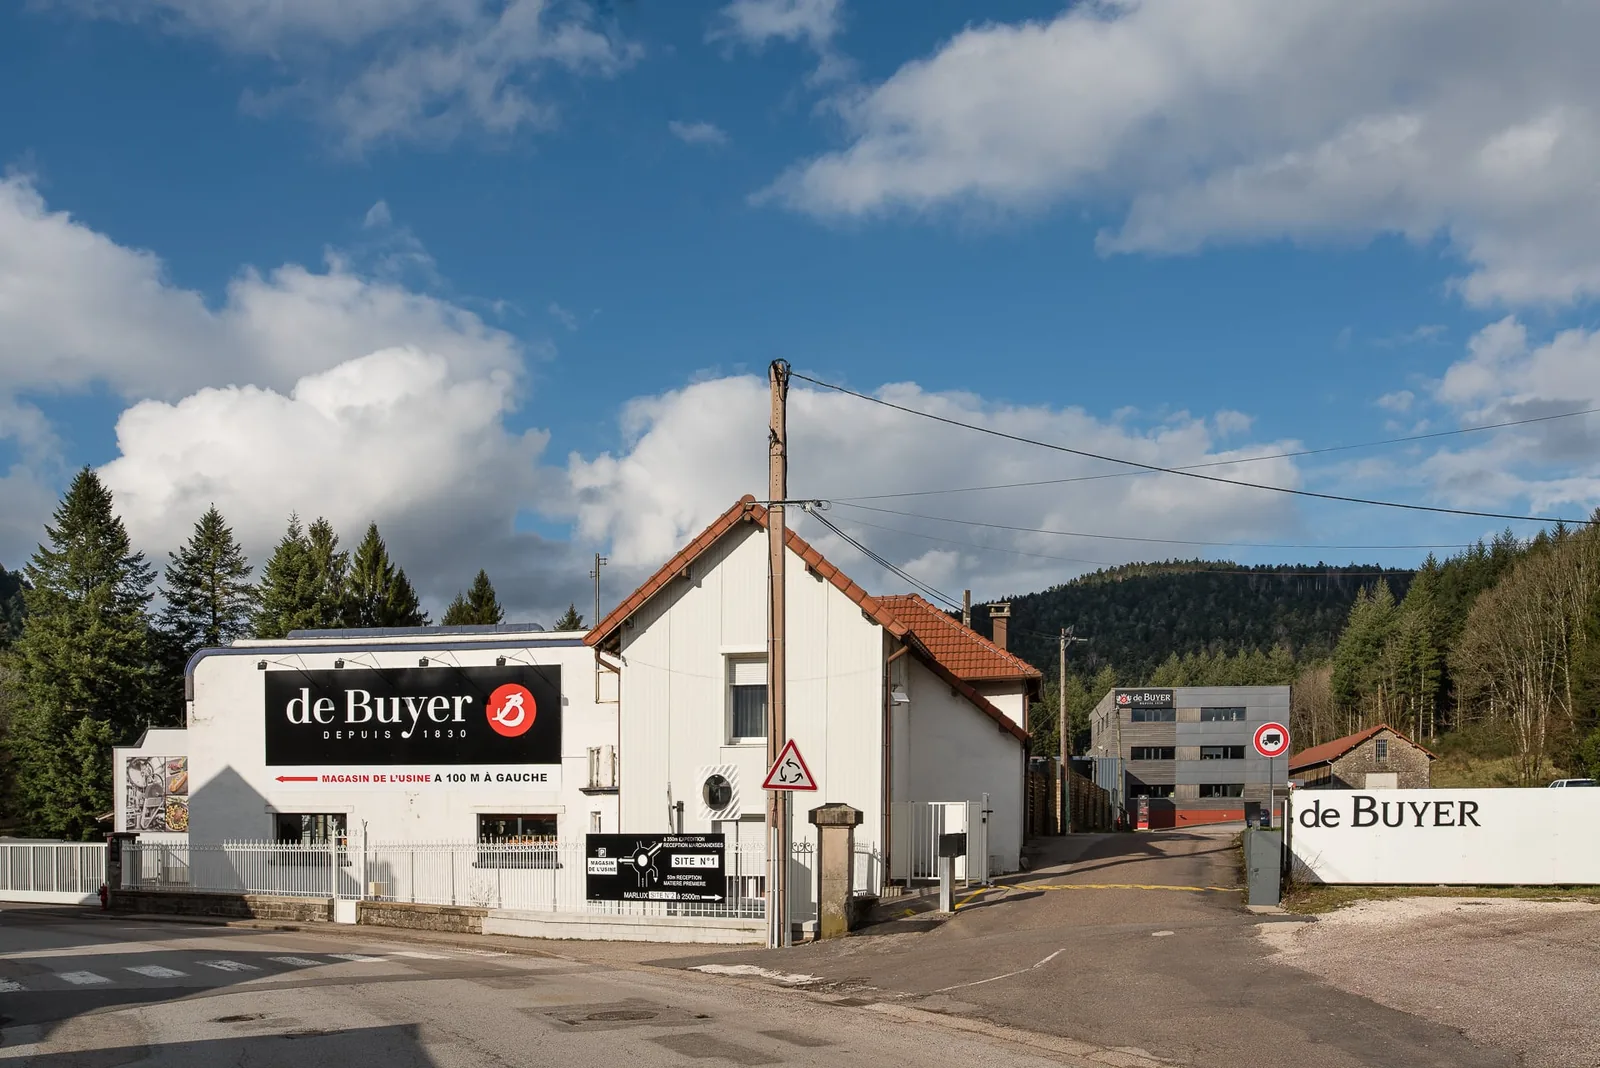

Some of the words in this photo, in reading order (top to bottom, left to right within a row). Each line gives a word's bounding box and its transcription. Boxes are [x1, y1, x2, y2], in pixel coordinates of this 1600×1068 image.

[1144, 693, 1171, 701] BUYER
[286, 688, 335, 724] de
[344, 689, 473, 739] Buyer
[323, 730, 391, 739] DEPUIS
[423, 729, 466, 739] 1830
[322, 774, 370, 783] MAGASIN
[373, 774, 387, 783] DE
[390, 774, 431, 783] L'USINE
[434, 773, 443, 783] A
[446, 773, 466, 783] 100
[470, 773, 480, 783] M
[484, 771, 492, 783] À
[495, 773, 548, 783] GAUCHE
[1299, 799, 1341, 829] de
[1350, 795, 1482, 829] BUYER
[674, 857, 695, 866] SITE
[700, 857, 715, 866] N°1
[624, 891, 648, 899] MARLUX
